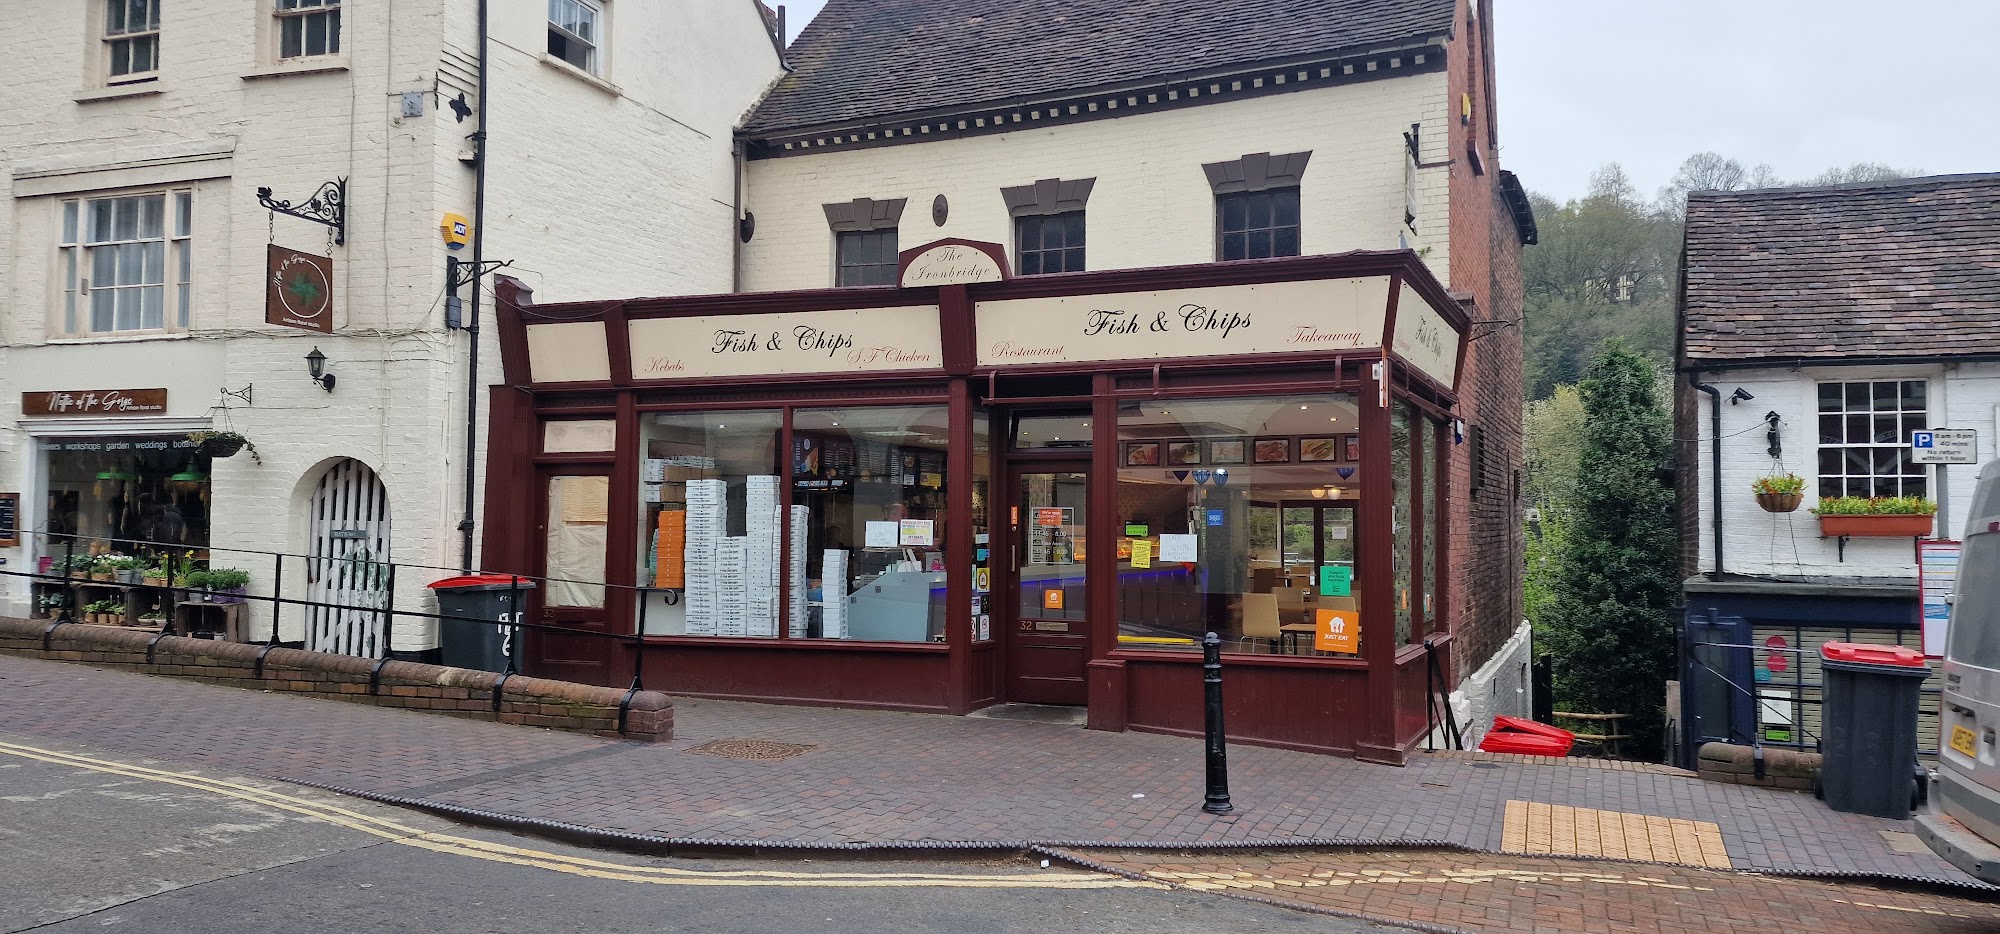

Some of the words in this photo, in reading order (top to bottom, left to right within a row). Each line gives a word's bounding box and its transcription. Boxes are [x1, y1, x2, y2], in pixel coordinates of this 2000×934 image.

[454, 223, 467, 235] ADT
[937, 246, 963, 262] The
[912, 264, 990, 281] Ironbridge
[1083, 309, 1141, 336] Fish
[1150, 311, 1169, 332] &
[1178, 303, 1252, 339] Chips
[711, 329, 759, 354] Fish
[766, 331, 783, 351] &
[793, 325, 853, 357] Chips
[1287, 325, 1362, 348] Takeaway
[846, 350, 861, 365] S
[863, 348, 886, 364] F
[881, 346, 930, 363] Chicken
[991, 341, 1065, 360] Restaurant
[644, 356, 685, 373] Kebabs
[101, 391, 133, 412] Gorge
[65, 442, 101, 452] workshops
[106, 442, 129, 452] garden
[135, 441, 168, 451] weddings
[1918, 434, 1931, 447] P
[1020, 620, 1032, 631] 32
